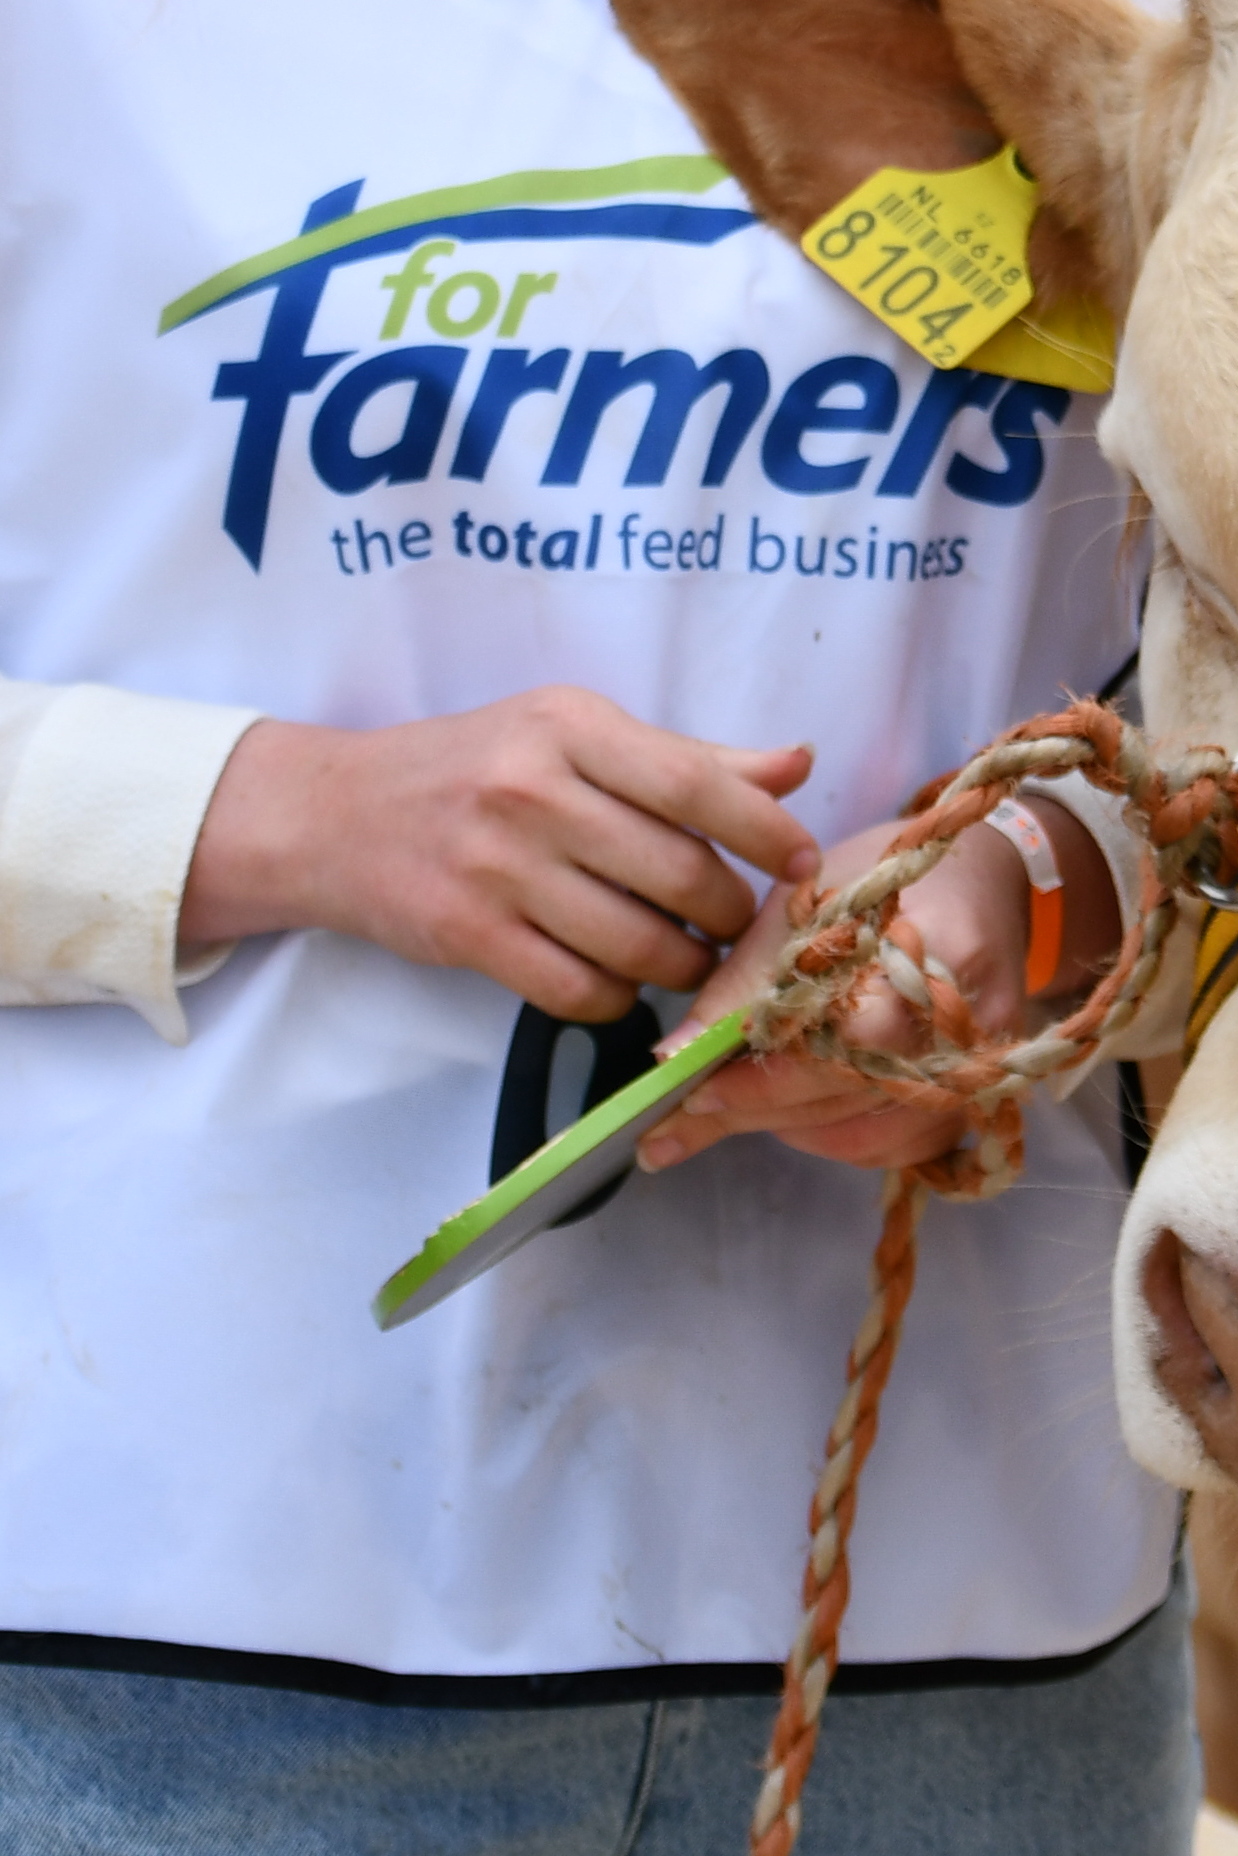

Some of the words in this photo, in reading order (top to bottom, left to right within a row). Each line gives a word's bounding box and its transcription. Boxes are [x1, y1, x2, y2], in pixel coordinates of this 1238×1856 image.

[911, 185, 943, 223] NL
[379, 240, 558, 341] for
[816, 210, 974, 345] 8104
[954, 228, 1022, 286] 6618
[212, 178, 1071, 575] farmers
[333, 518, 433, 576] the
[453, 511, 599, 573] total
[618, 513, 722, 573] feed
[749, 516, 969, 582] business
